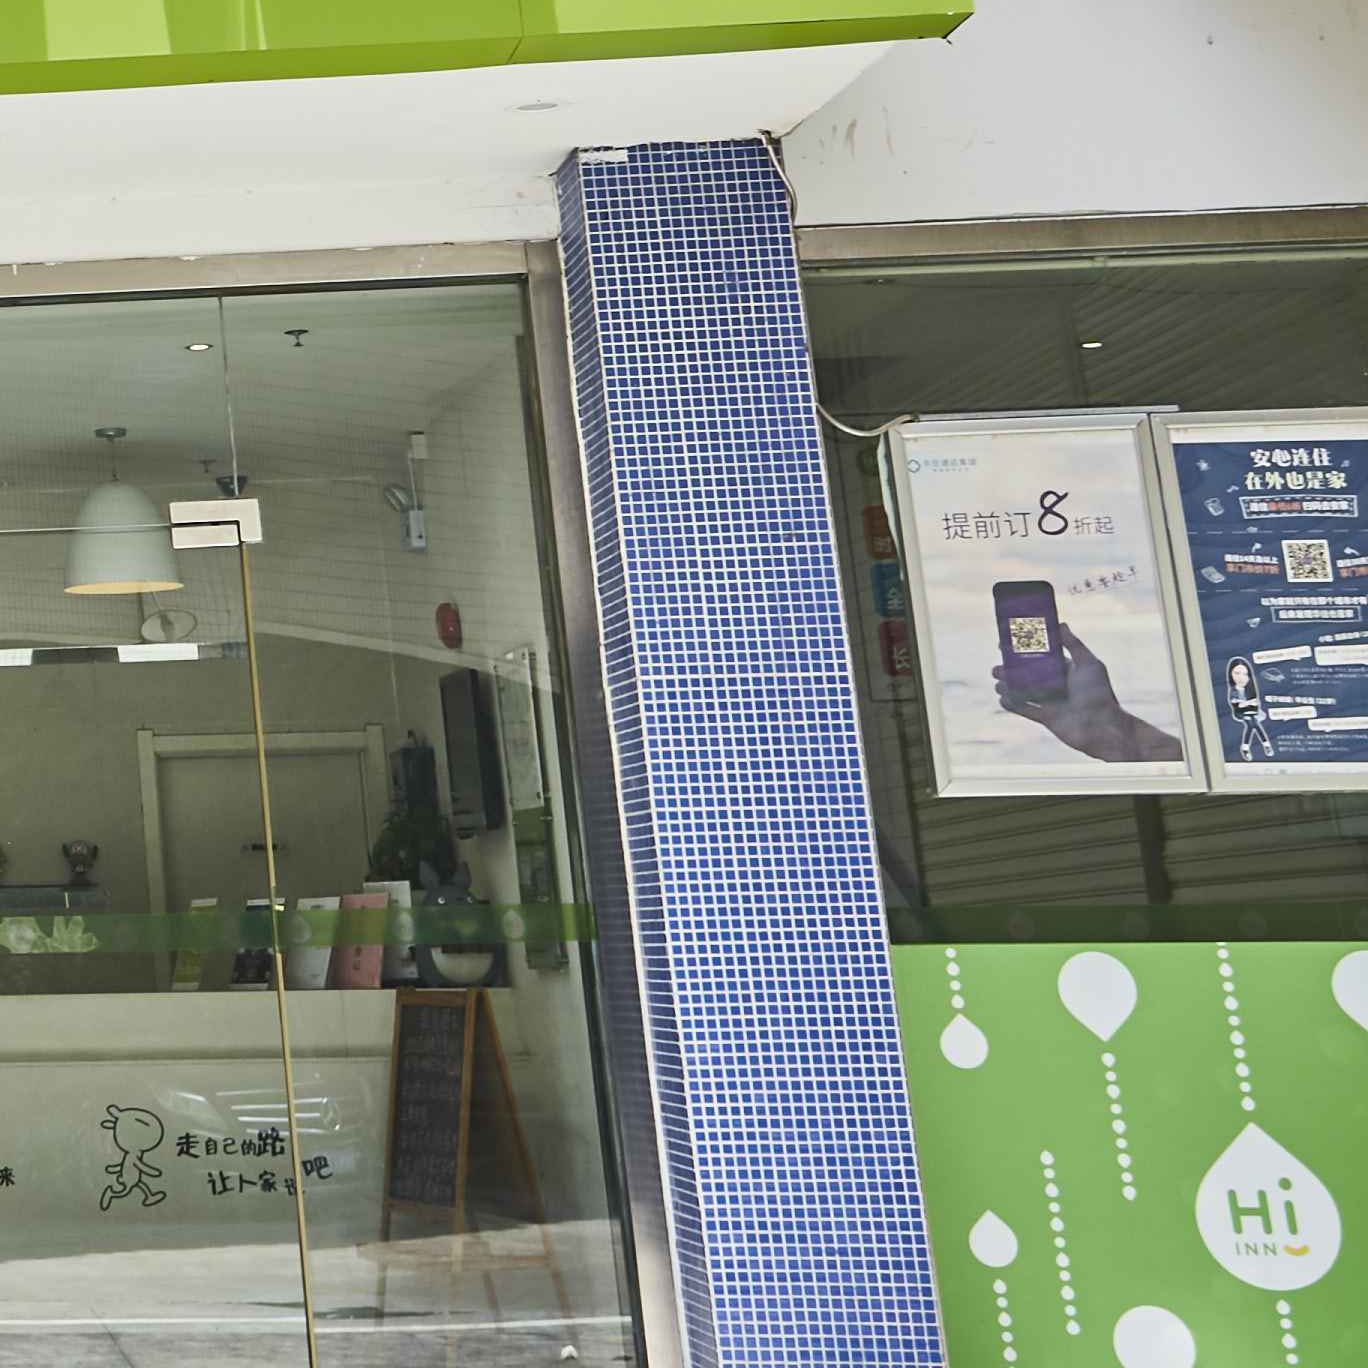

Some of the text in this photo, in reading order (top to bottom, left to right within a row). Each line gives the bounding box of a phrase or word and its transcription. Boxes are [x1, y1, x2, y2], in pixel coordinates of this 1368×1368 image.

[942, 490, 1115, 540] 提前订8折起
[176, 1127, 285, 1158] 走自己的路
[1227, 1177, 1298, 1235] Hi
[1235, 1241, 1277, 1256] INN
